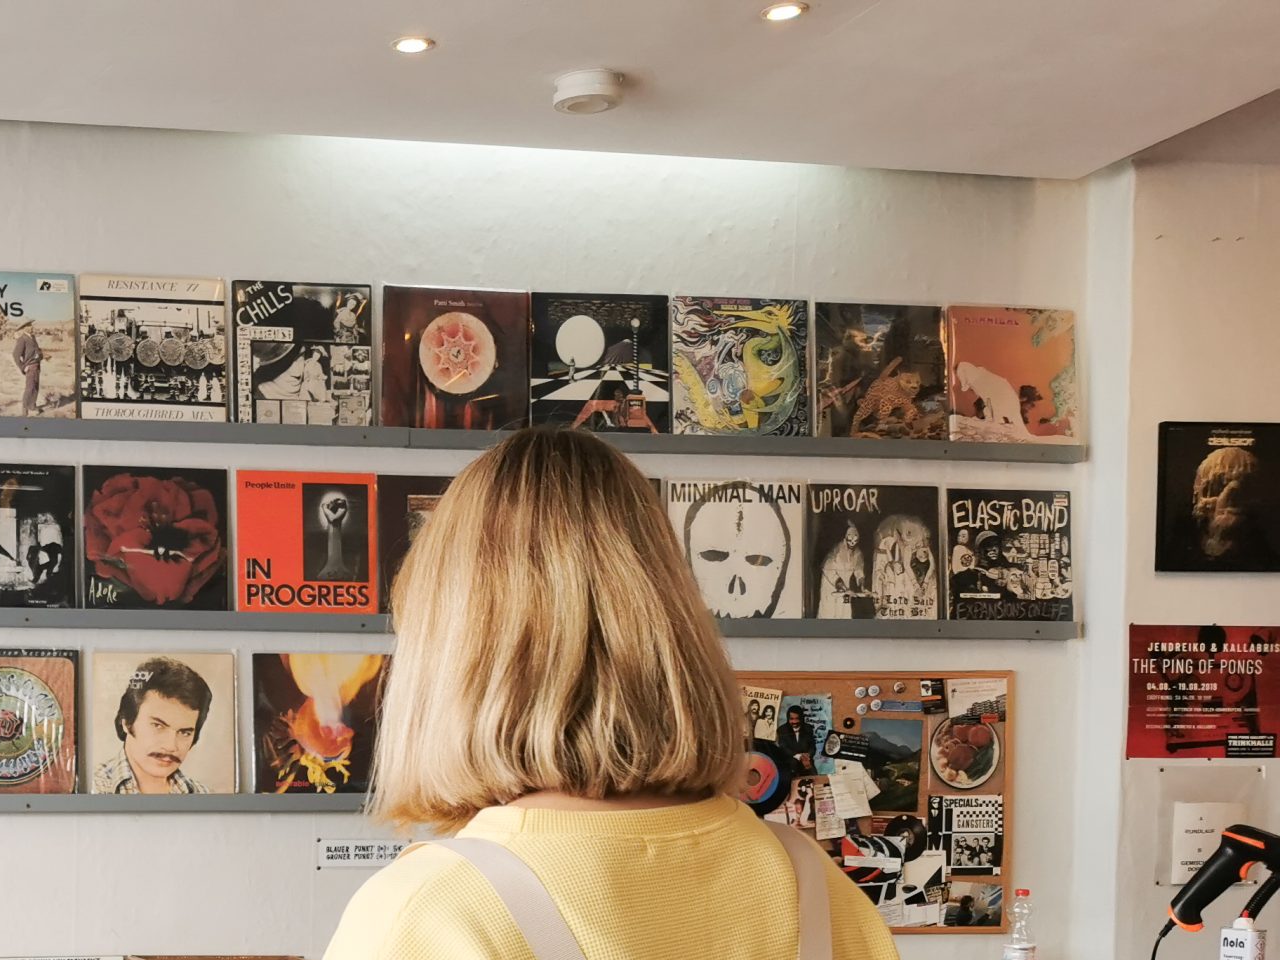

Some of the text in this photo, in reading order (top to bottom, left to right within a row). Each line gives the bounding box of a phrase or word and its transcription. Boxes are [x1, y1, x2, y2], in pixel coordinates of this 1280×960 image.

[107, 280, 178, 291] RESISTANCE
[245, 281, 264, 295] THE
[94, 407, 213, 420] THOROUGHBRED MEN
[245, 481, 296, 490] People Unite
[671, 482, 801, 504] MINIMAL MAN
[809, 487, 882, 514] UPROAR
[1021, 498, 1069, 532] BAND
[246, 558, 271, 580] IN
[246, 583, 370, 607] PROGRESS
[1147, 642, 1206, 652] JENDREIKO
[1210, 643, 1218, 652] &
[1132, 658, 1263, 674] THE PING OF PONGS
[943, 798, 979, 808] SPECIALS
[957, 819, 994, 829] GANGSTERS
[326, 845, 374, 853] BLAUER PUNKT
[354, 853, 374, 861] PUNKT
[1222, 936, 1245, 949] Nola
